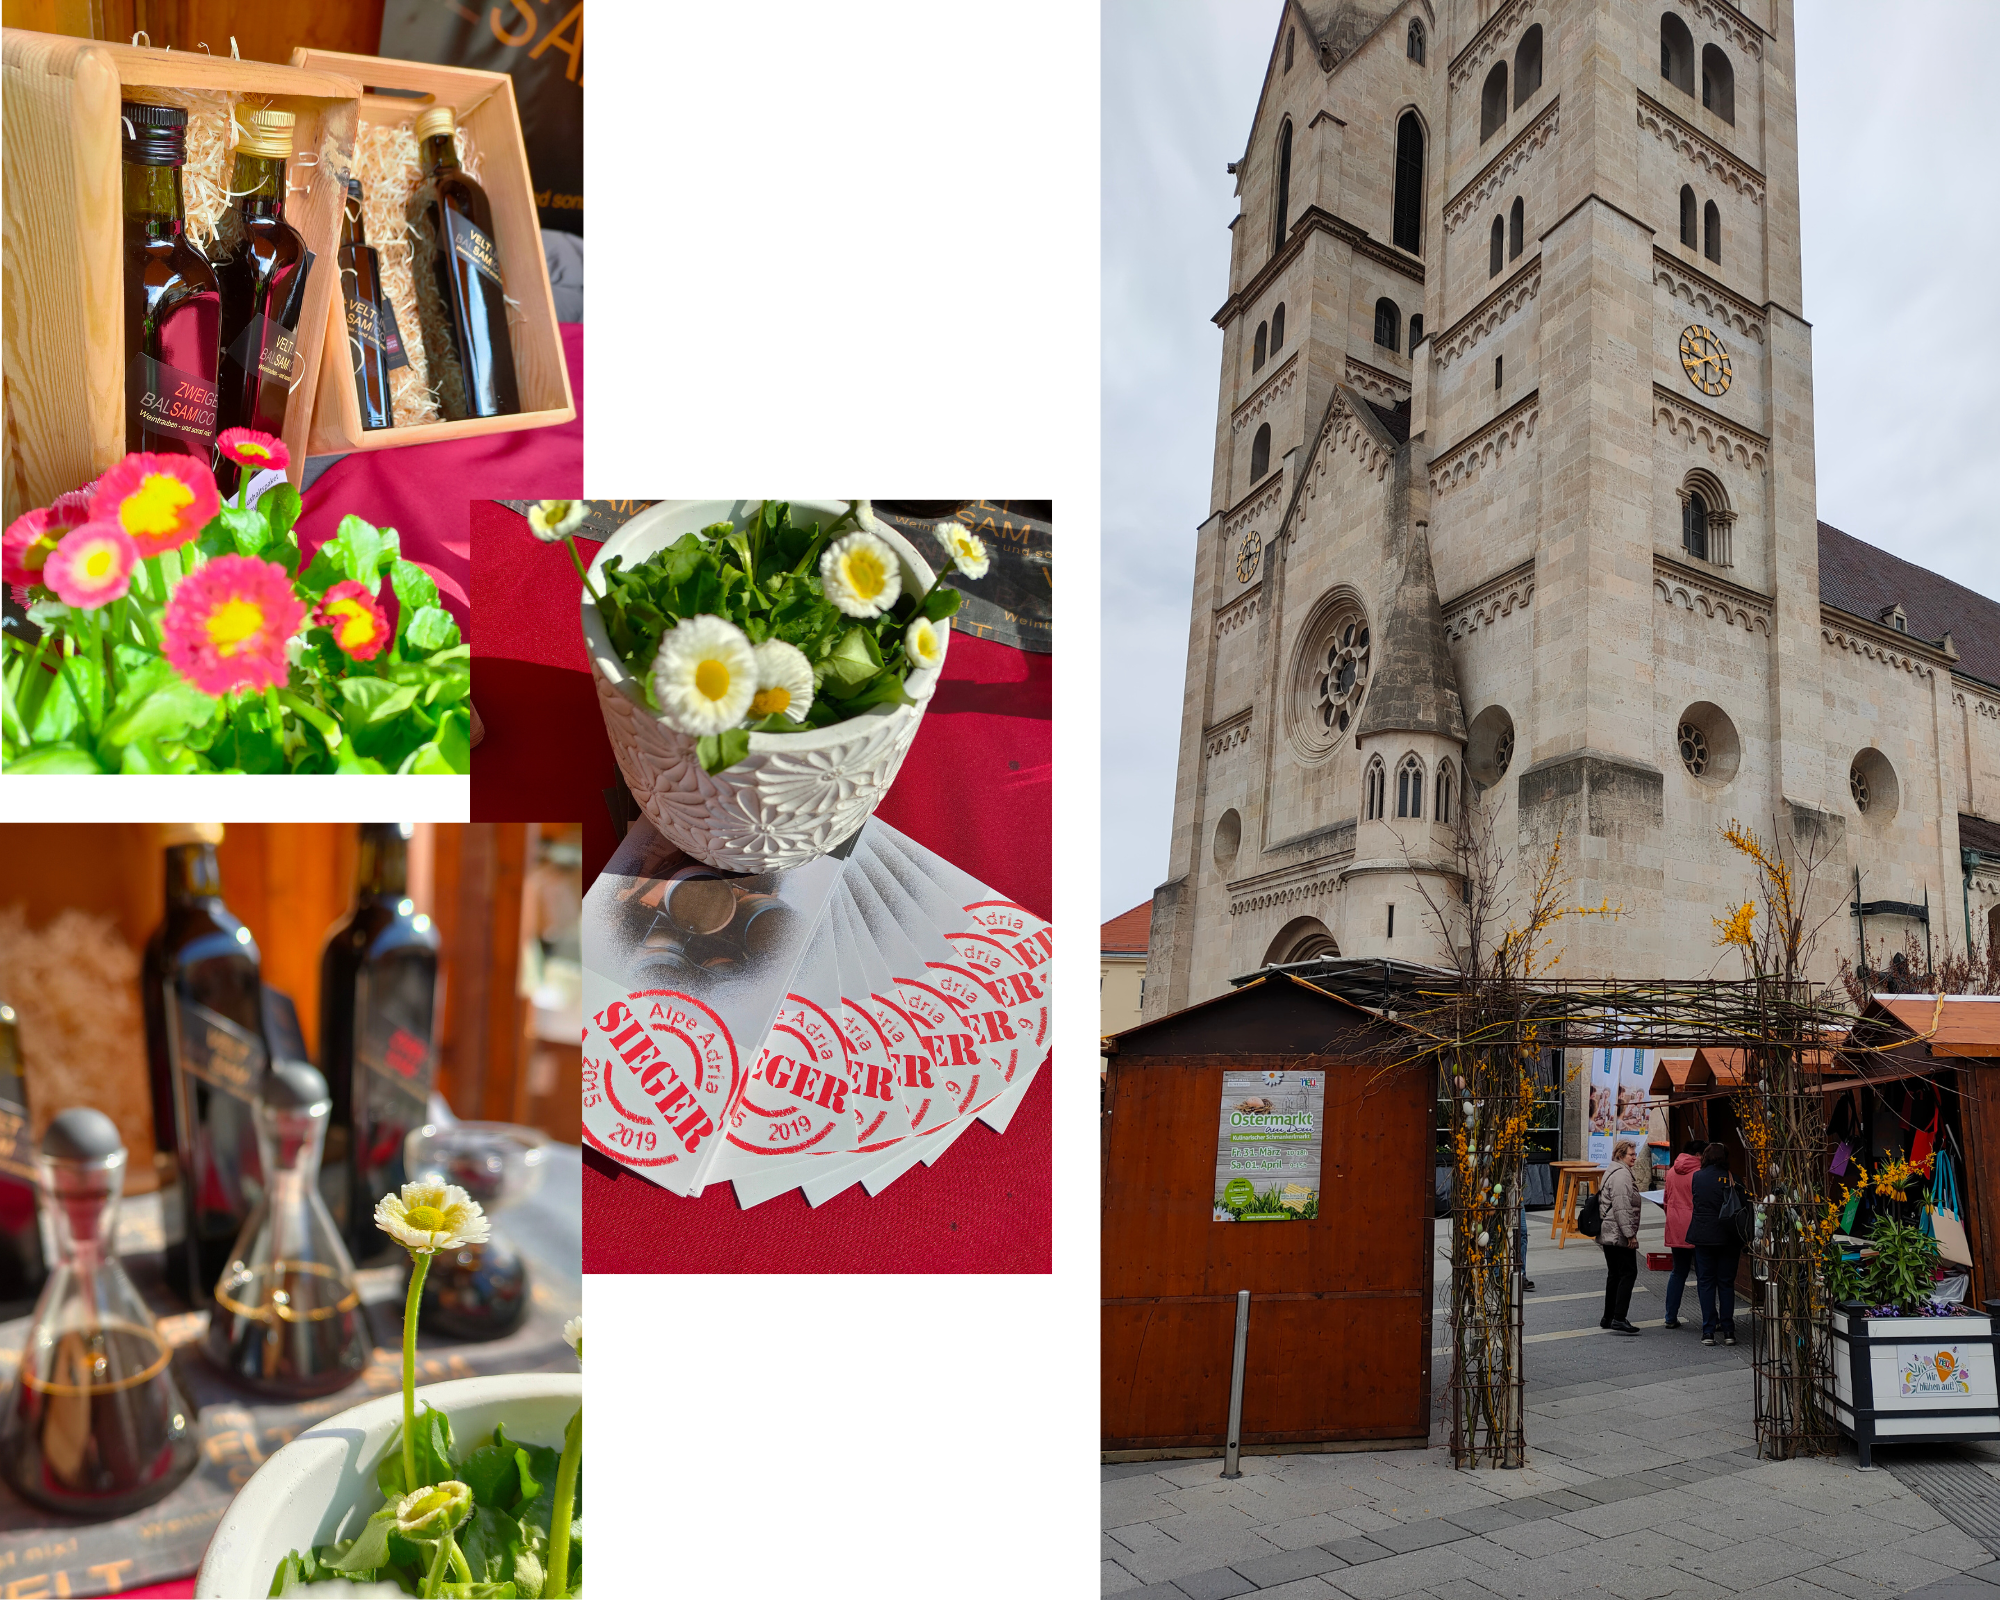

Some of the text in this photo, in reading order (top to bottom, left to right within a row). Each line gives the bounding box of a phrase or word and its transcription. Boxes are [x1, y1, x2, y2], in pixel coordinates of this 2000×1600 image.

[490, 0, 584, 87] SA
[139, 409, 178, 428] Weintrauben
[140, 391, 216, 426] BALSAMICO
[649, 1002, 725, 1094] Alpe Adria
[582, 1056, 602, 1108] 2015
[592, 1001, 714, 1154] SIEGER
[768, 1115, 812, 1142] 2019
[1230, 1112, 1313, 1126] Ostermarkt
[607, 1122, 657, 1151] 2019
[1230, 1160, 1243, 1169] Sa.
[1245, 1161, 1259, 1169] 01.
[1260, 1160, 1282, 1171] April
[1231, 1148, 1242, 1157] Fr.
[1243, 1148, 1257, 1157] 31.
[1259, 1147, 1281, 1156] März
[1919, 1382, 1941, 1391] blühen
[1925, 1372, 1938, 1381] Wir
